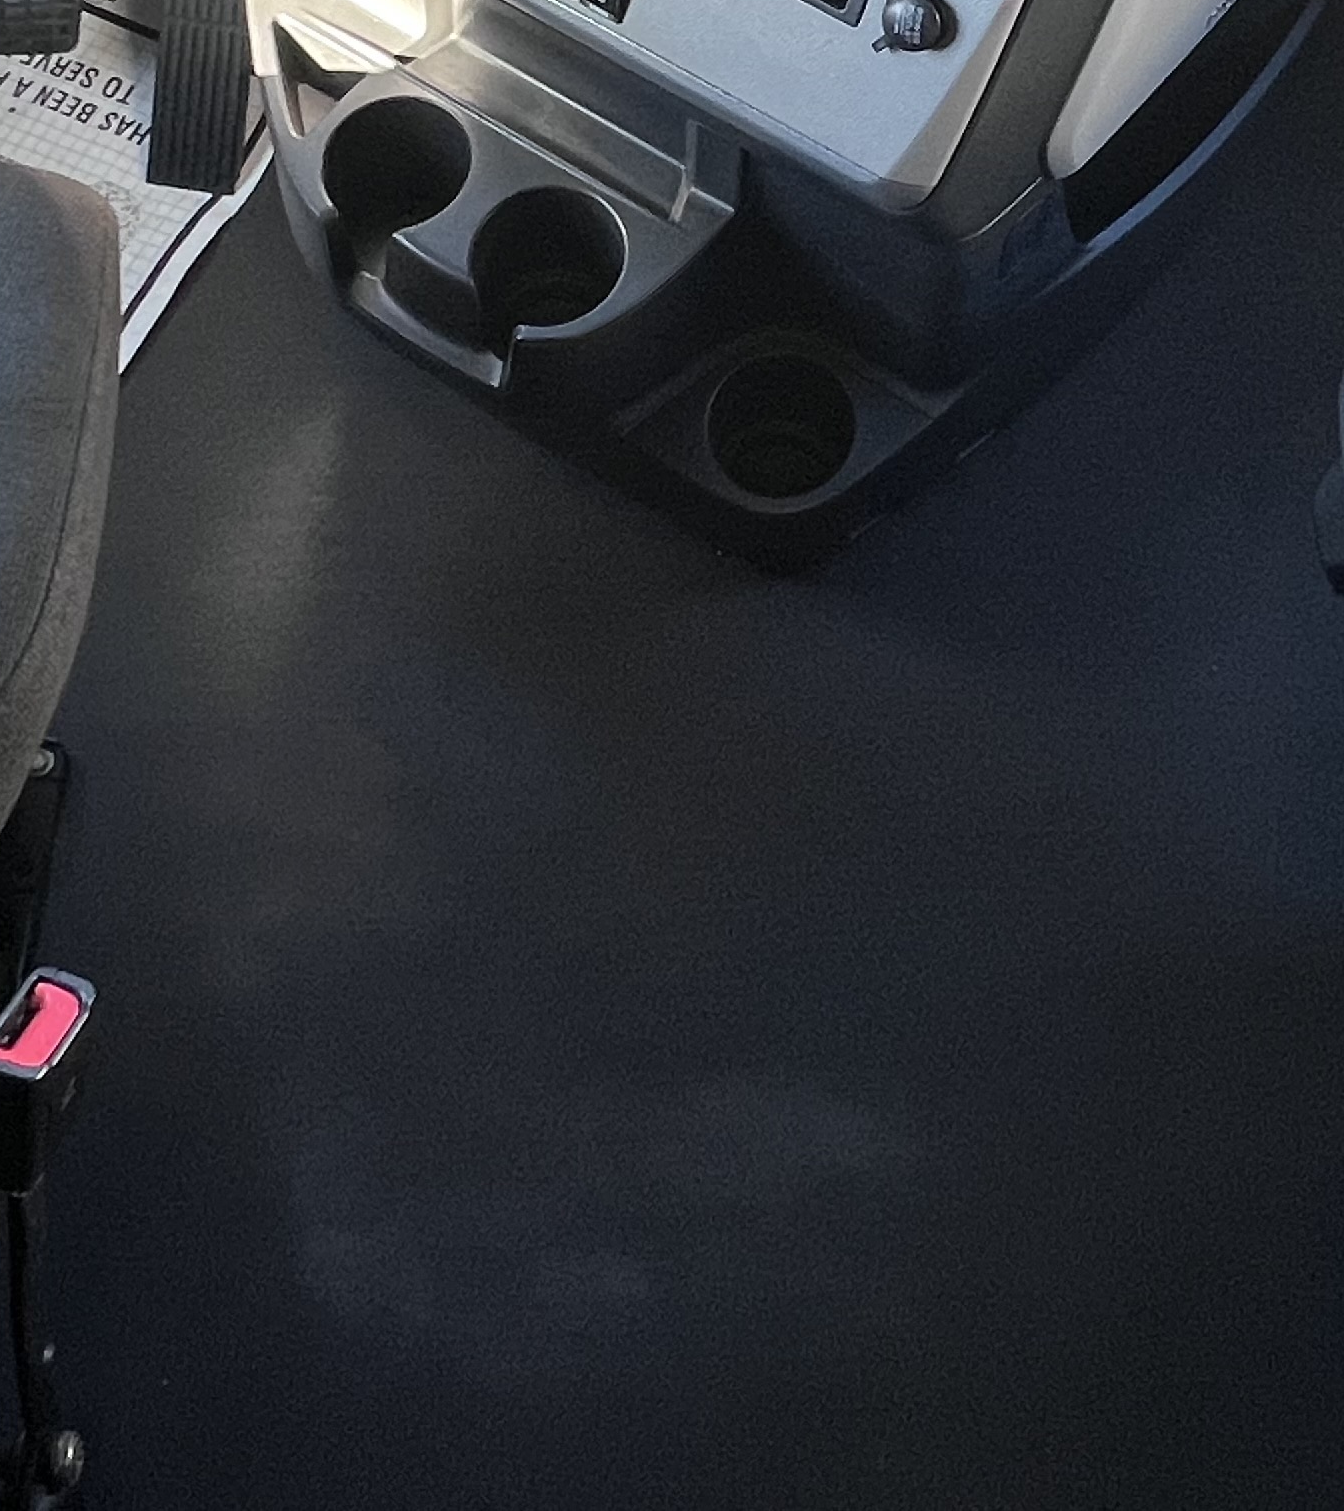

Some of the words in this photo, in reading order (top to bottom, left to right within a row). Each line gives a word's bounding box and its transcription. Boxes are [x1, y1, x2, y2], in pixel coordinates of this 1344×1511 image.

[12, 76, 35, 98] A
[101, 76, 136, 105] TO
[31, 84, 99, 124] BEEN
[97, 111, 151, 146] HAS
